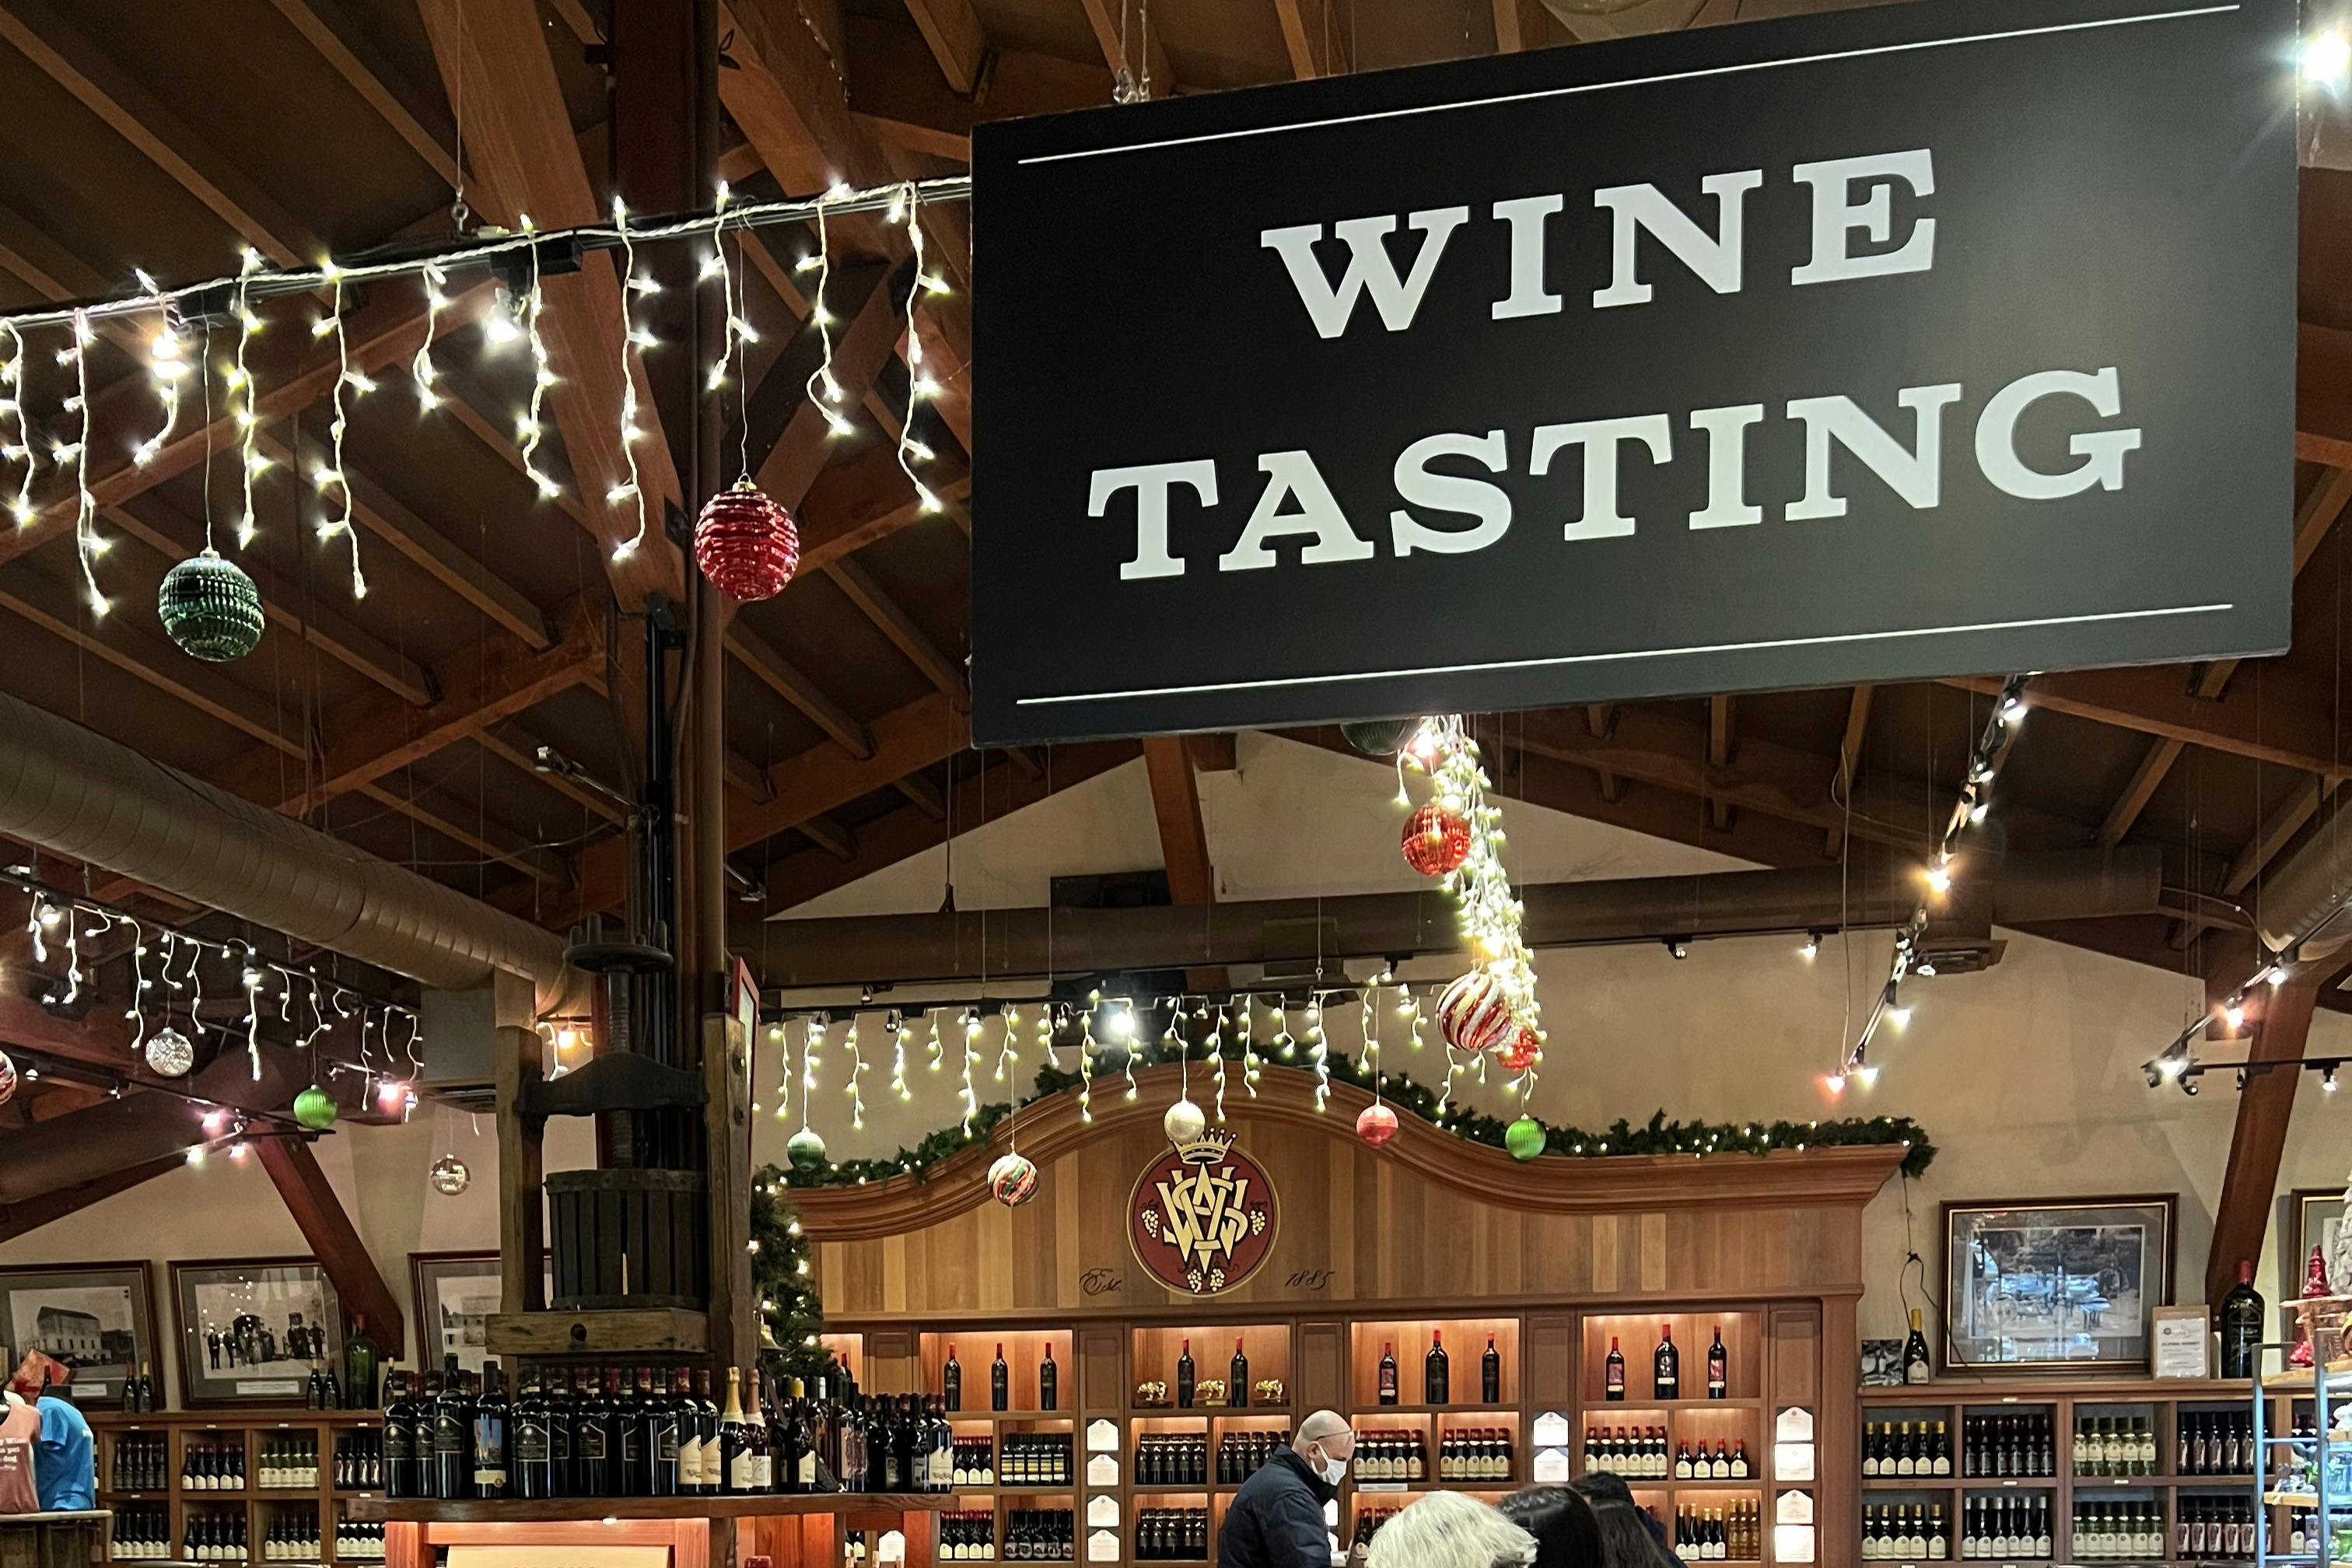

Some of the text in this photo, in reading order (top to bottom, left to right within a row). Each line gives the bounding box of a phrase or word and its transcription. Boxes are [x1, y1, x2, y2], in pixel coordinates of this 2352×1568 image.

[1261, 148, 1937, 340] WINE
[1087, 366, 2142, 581] TASTING
[1284, 1269, 1335, 1291] 1885
